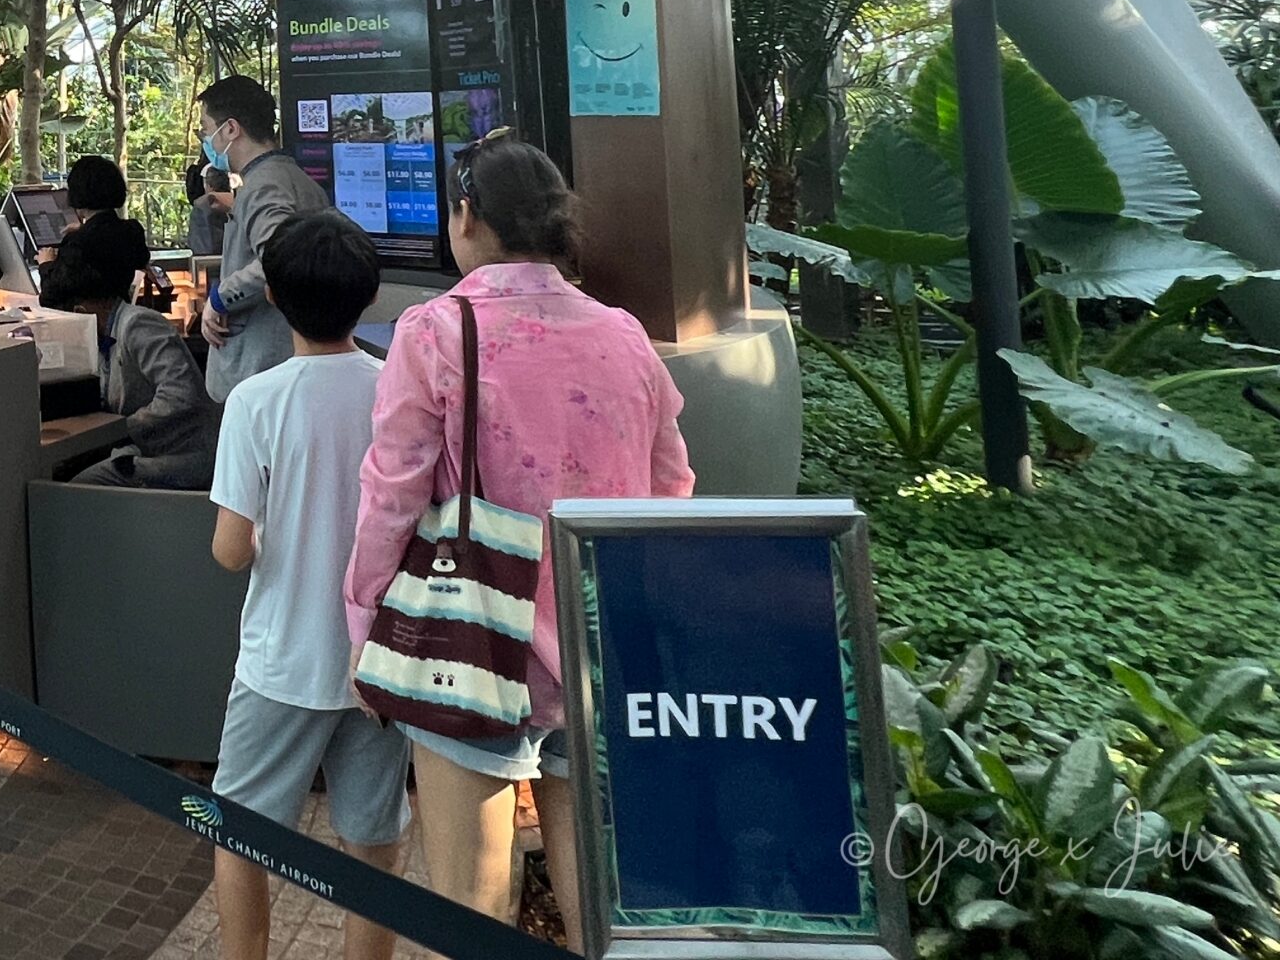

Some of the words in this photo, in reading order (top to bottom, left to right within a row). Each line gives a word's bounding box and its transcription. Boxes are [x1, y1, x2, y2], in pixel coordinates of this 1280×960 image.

[289, 17, 343, 36] Bundle
[346, 14, 391, 32] Deals
[626, 692, 818, 742] ENTRY
[185, 816, 222, 843] JEWEL
[227, 836, 275, 869] CHANGI
[280, 863, 334, 898] AIRPORT
